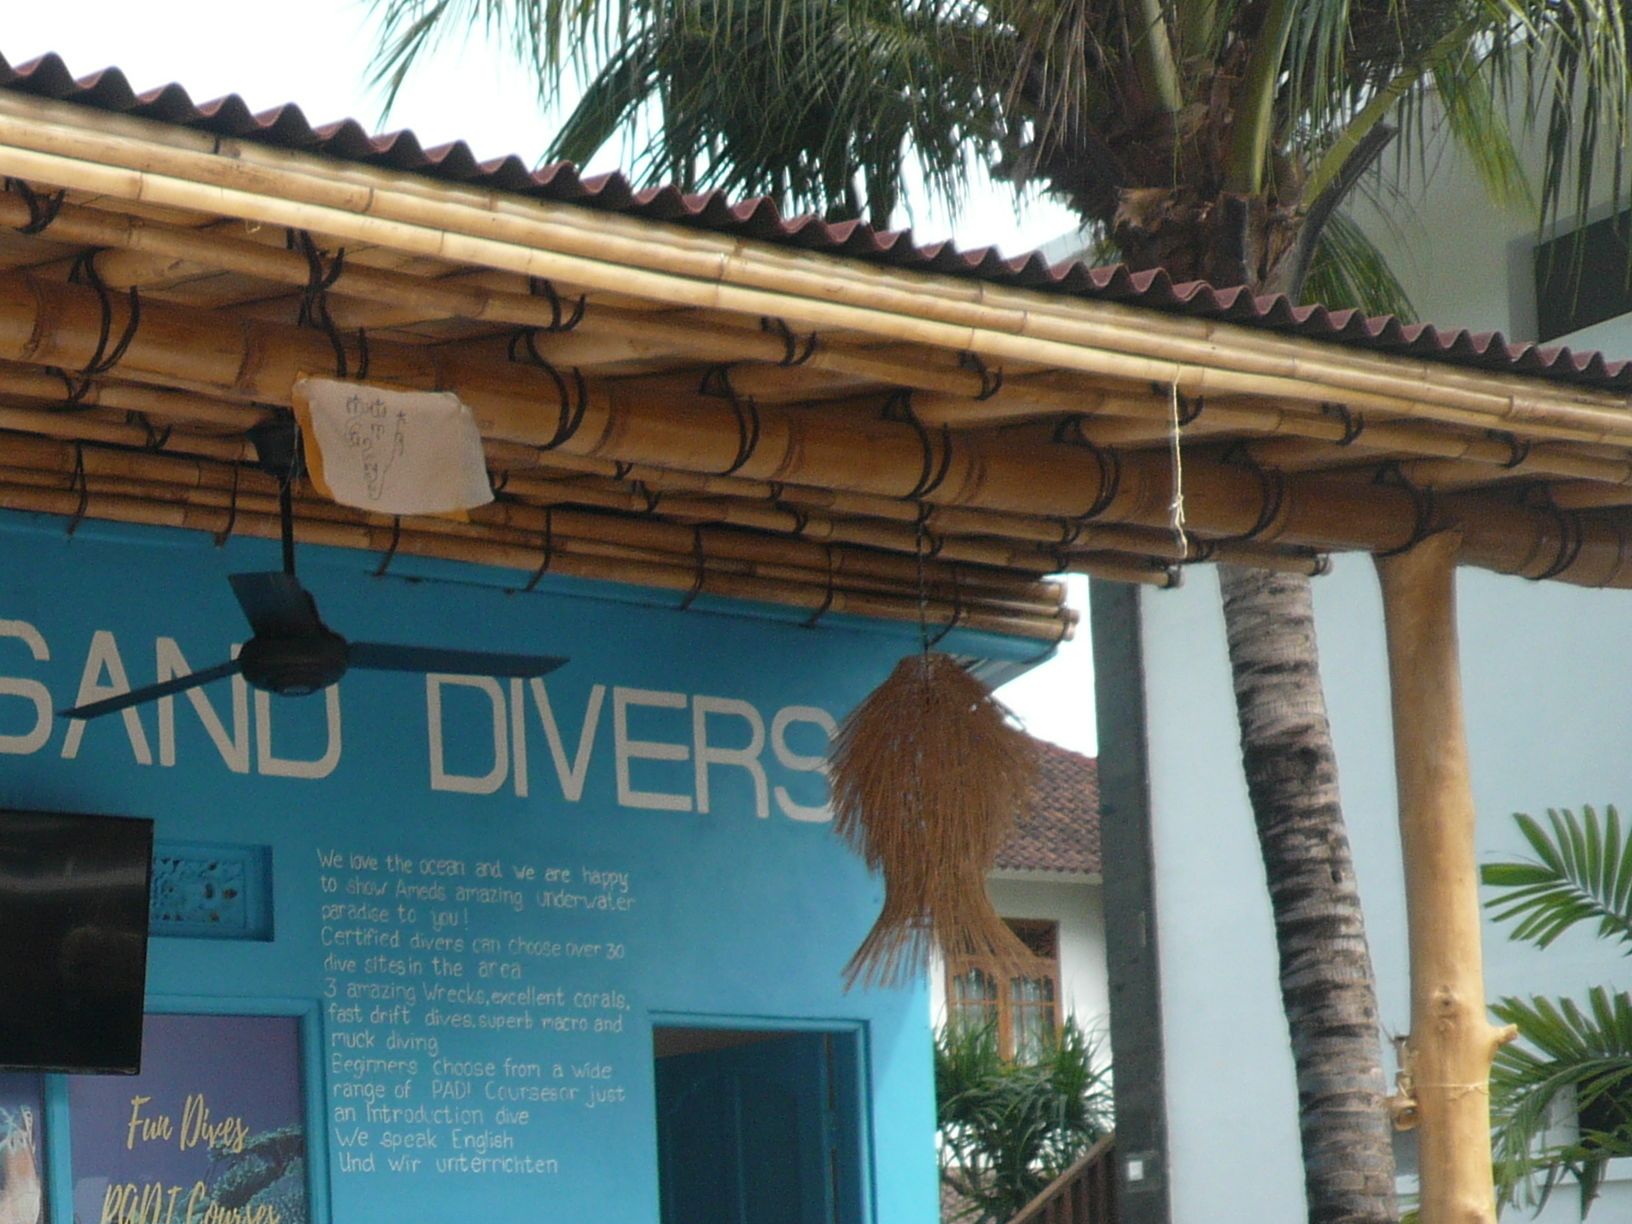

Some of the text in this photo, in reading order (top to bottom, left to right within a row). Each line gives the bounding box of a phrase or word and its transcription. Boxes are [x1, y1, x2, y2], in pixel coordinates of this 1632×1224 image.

[426, 672, 834, 823] DIVERS
[317, 848, 343, 868] We
[350, 852, 378, 870] love
[386, 854, 412, 873] the
[420, 859, 465, 875] ocean
[475, 860, 502, 878] and
[545, 868, 570, 882] are
[582, 865, 629, 893] happy
[320, 875, 337, 892] to
[346, 876, 388, 896] show
[395, 879, 446, 900] Ameds
[456, 886, 523, 912] amazing
[322, 902, 389, 922] paradise
[398, 904, 416, 923] to
[321, 926, 400, 946] Certified
[410, 933, 464, 952] divers
[472, 938, 501, 953] can
[606, 943, 624, 960] 30
[324, 952, 357, 972] dive
[432, 956, 463, 977] the
[479, 960, 522, 979] area
[324, 978, 336, 997] 3
[347, 981, 416, 1006] amazing
[328, 1003, 363, 1023] fast
[370, 1005, 410, 1024] drift
[542, 1017, 588, 1031] macro
[594, 1014, 623, 1032] and
[331, 1030, 439, 1057] muck diving
[332, 1053, 418, 1079] Beginners
[504, 1058, 540, 1077] from
[553, 1064, 564, 1078] a
[572, 1062, 612, 1079] wide
[333, 1082, 385, 1105] range
[394, 1080, 412, 1098] of
[585, 1085, 625, 1108] just
[126, 1093, 250, 1154] Fun Dives
[335, 1106, 356, 1122] an
[496, 1105, 529, 1125] dive
[335, 1126, 514, 1154] We speak English
[339, 1151, 559, 1173] Und wir unterrichten
